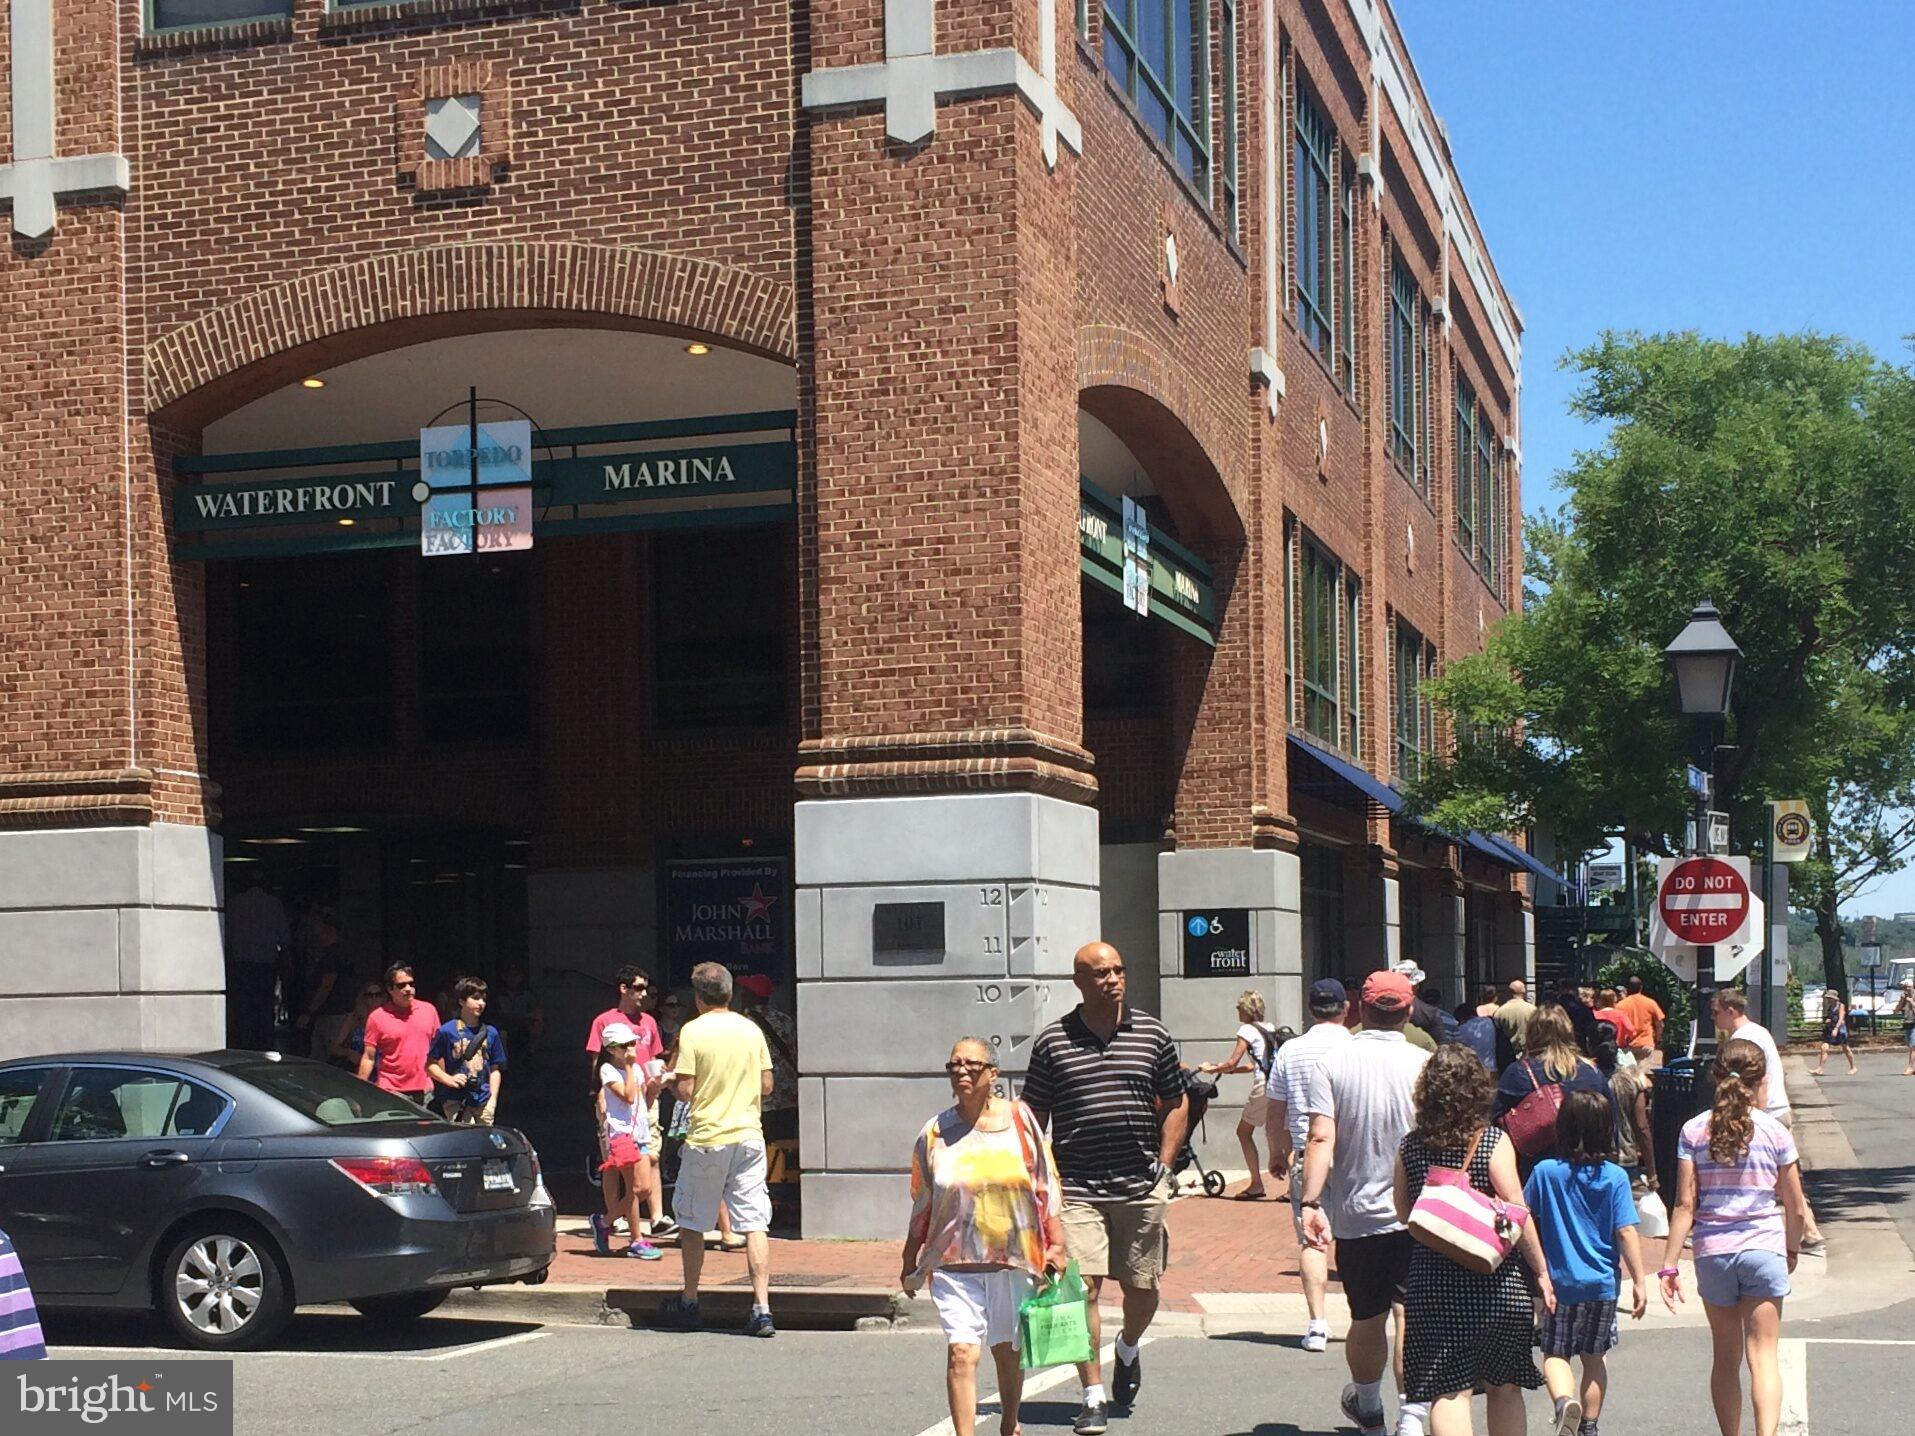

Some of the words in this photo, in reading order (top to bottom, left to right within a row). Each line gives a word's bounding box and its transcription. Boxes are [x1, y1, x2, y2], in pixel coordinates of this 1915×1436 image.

[424, 445, 522, 470] TORPEDO
[603, 456, 736, 490] MARINA
[194, 481, 396, 519] WATERFRONT
[429, 507, 518, 529] FACTORY
[672, 869, 718, 879] Financing
[721, 868, 762, 877] Provided
[764, 867, 777, 876] By
[1675, 877, 1695, 889] DO
[1704, 876, 1734, 888] NOT
[980, 888, 1002, 906] 12
[692, 904, 740, 922] JOHN
[1680, 913, 1727, 926] ENTER
[676, 925, 775, 941] MARSHALL
[983, 937, 1002, 953] 11
[1216, 948, 1246, 957] water
[1210, 952, 1246, 968] front
[976, 985, 1002, 1002] 10
[990, 1035, 1002, 1048] 9
[994, 1084, 1005, 1099] 8
